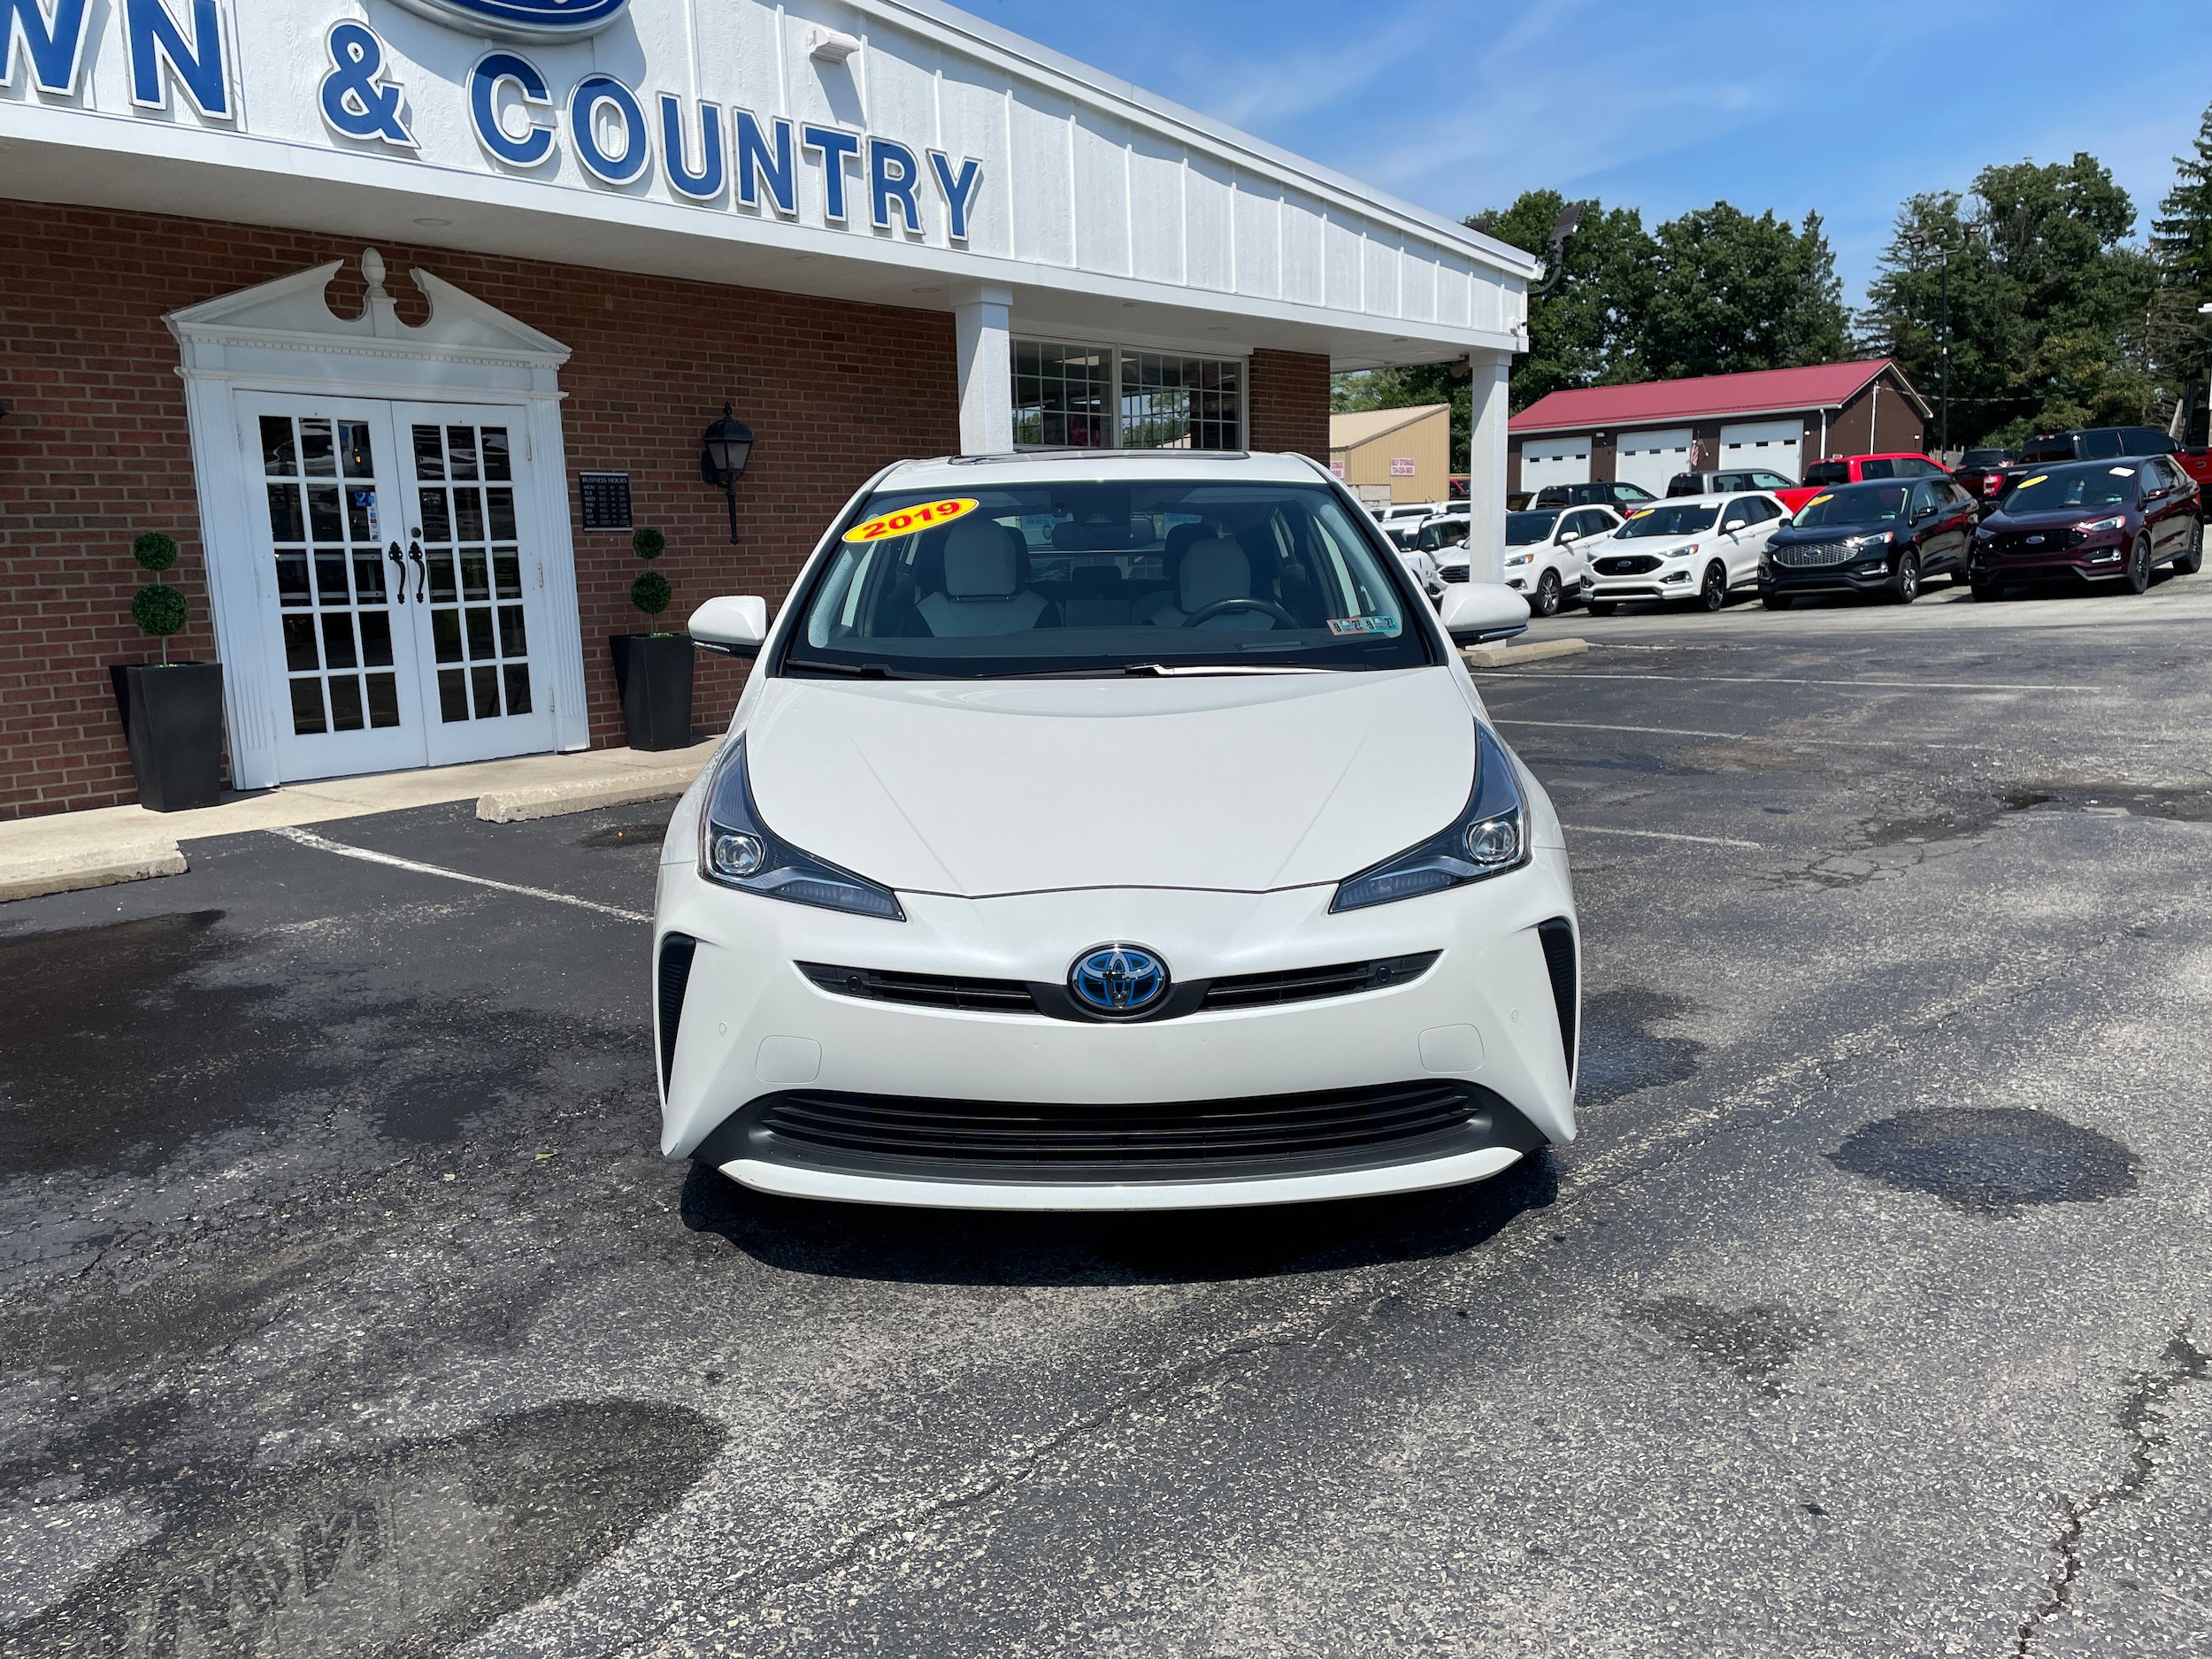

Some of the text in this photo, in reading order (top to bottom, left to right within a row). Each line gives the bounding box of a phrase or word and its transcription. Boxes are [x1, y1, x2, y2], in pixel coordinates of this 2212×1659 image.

[319, 19, 422, 149] &
[468, 50, 982, 241] COUNTRY
[862, 502, 962, 539] 2019
